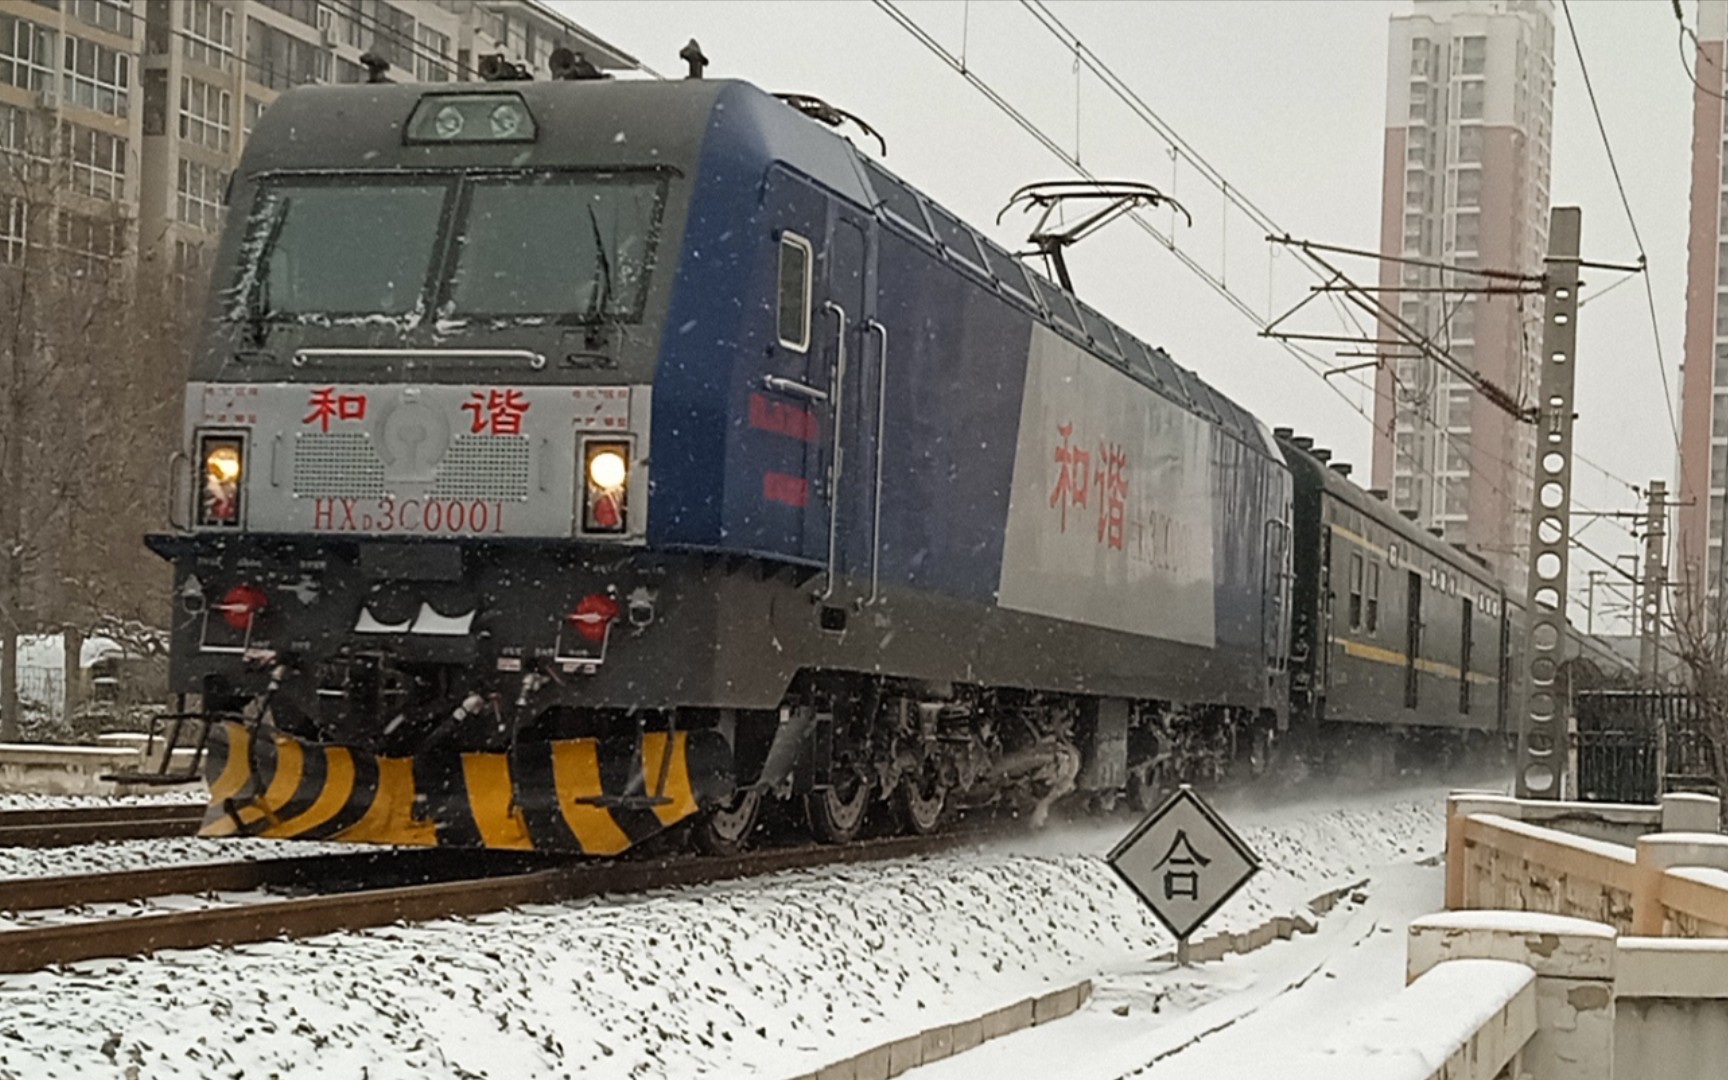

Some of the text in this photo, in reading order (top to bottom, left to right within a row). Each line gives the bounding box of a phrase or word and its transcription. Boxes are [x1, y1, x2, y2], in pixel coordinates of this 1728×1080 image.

[302, 387, 531, 435] 和 谐
[1050, 421, 1129, 551] 和谐
[1152, 828, 1211, 901] 合
